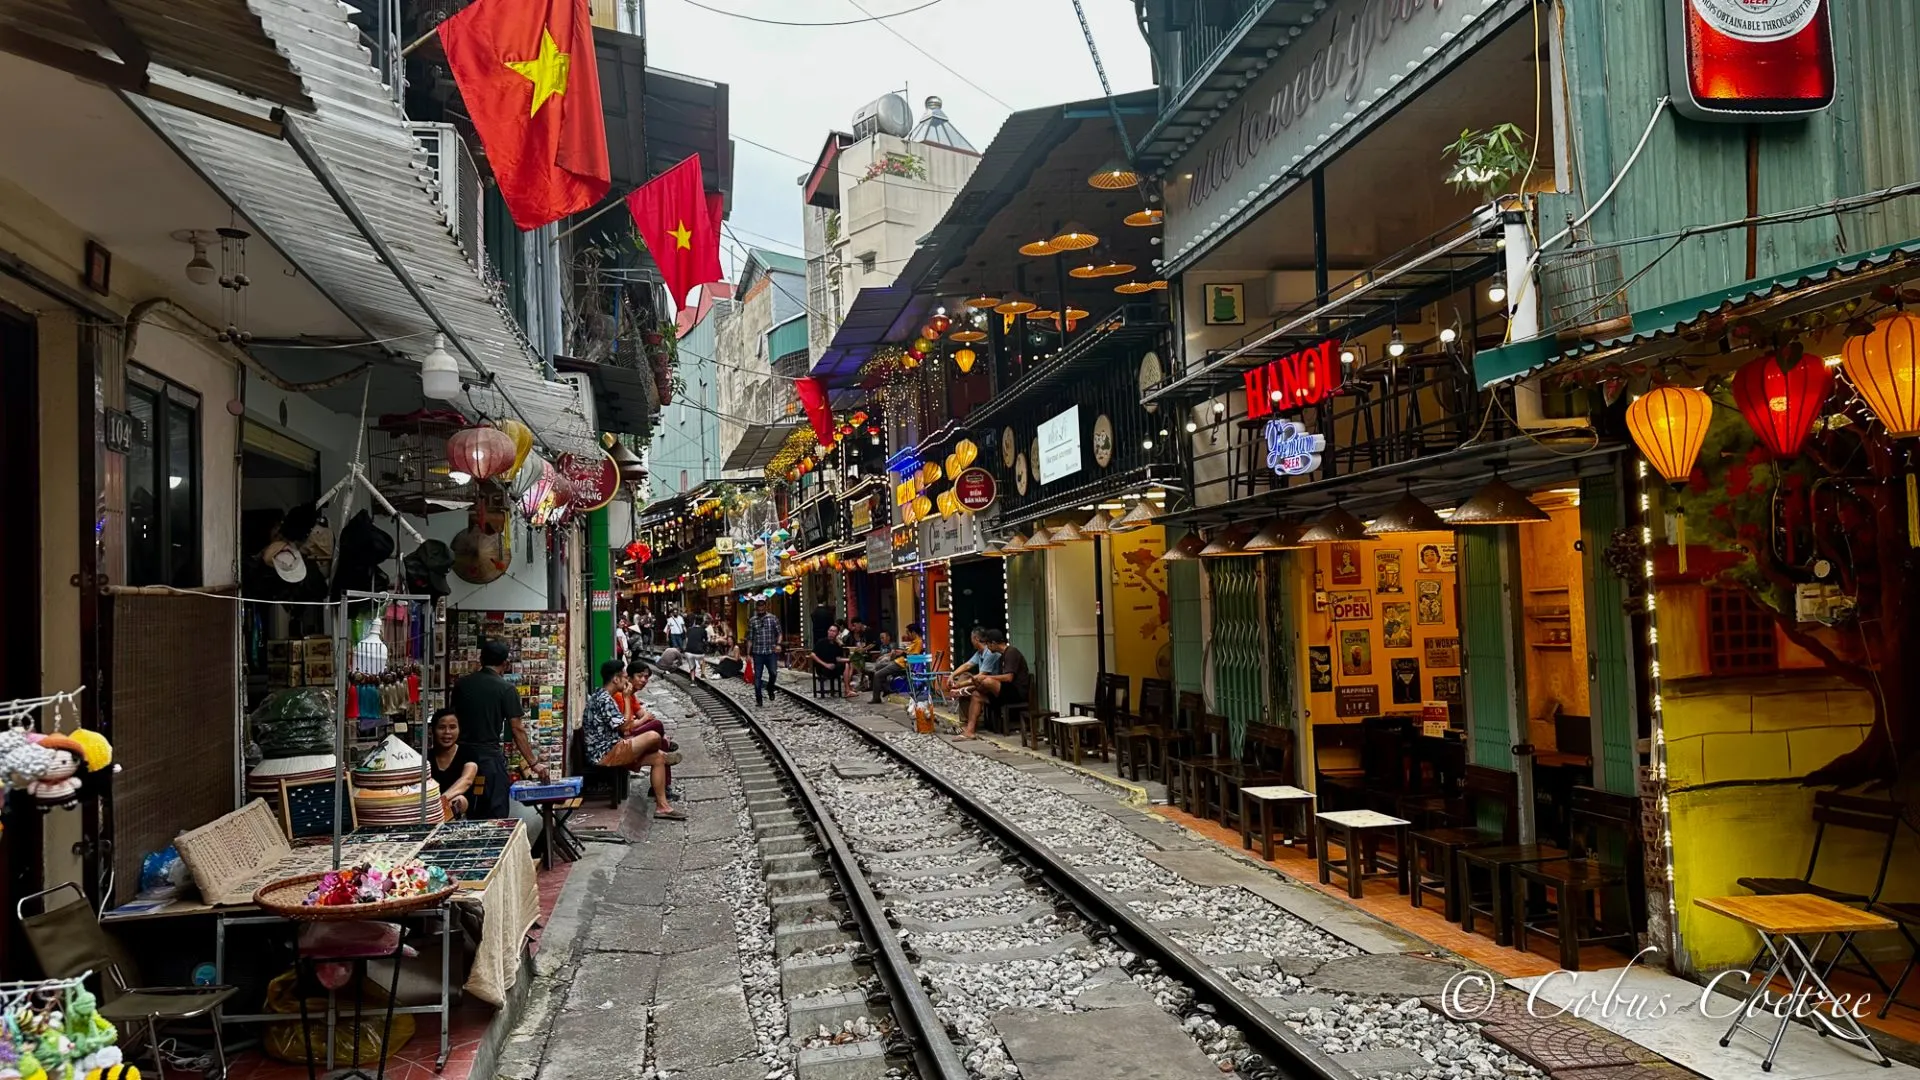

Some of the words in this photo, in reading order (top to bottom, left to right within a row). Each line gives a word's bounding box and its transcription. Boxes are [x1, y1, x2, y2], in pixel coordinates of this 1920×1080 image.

[1716, 9, 1761, 31] OBTAINABLE
[1762, 3, 1806, 31] THROUGHOUT
[1243, 340, 1343, 420] HANOI
[110, 417, 131, 448] 104
[1283, 456, 1301, 470] BEER
[1334, 603, 1370, 618] OPEN
[1345, 702, 1370, 710] LIFE
